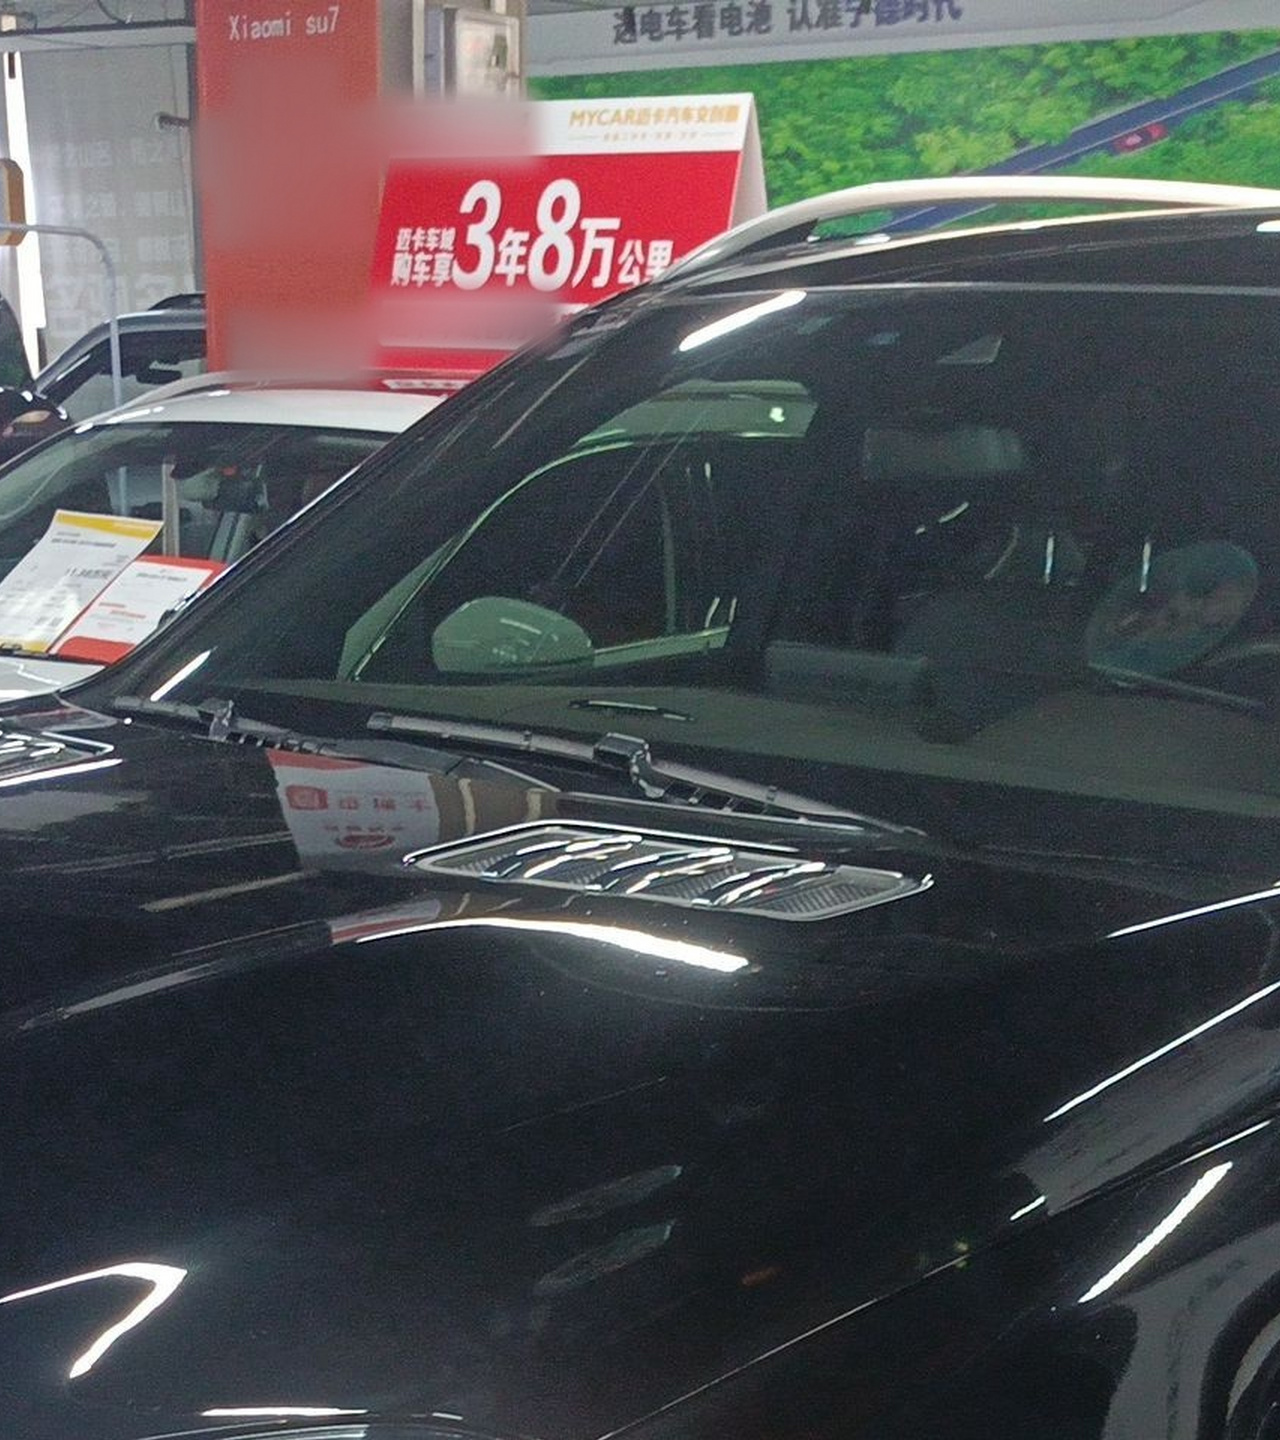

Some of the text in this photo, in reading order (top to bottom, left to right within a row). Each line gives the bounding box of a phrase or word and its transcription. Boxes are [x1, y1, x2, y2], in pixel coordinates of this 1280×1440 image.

[228, 6, 339, 41] Xiaomi su7
[390, 252, 454, 288] 购车享
